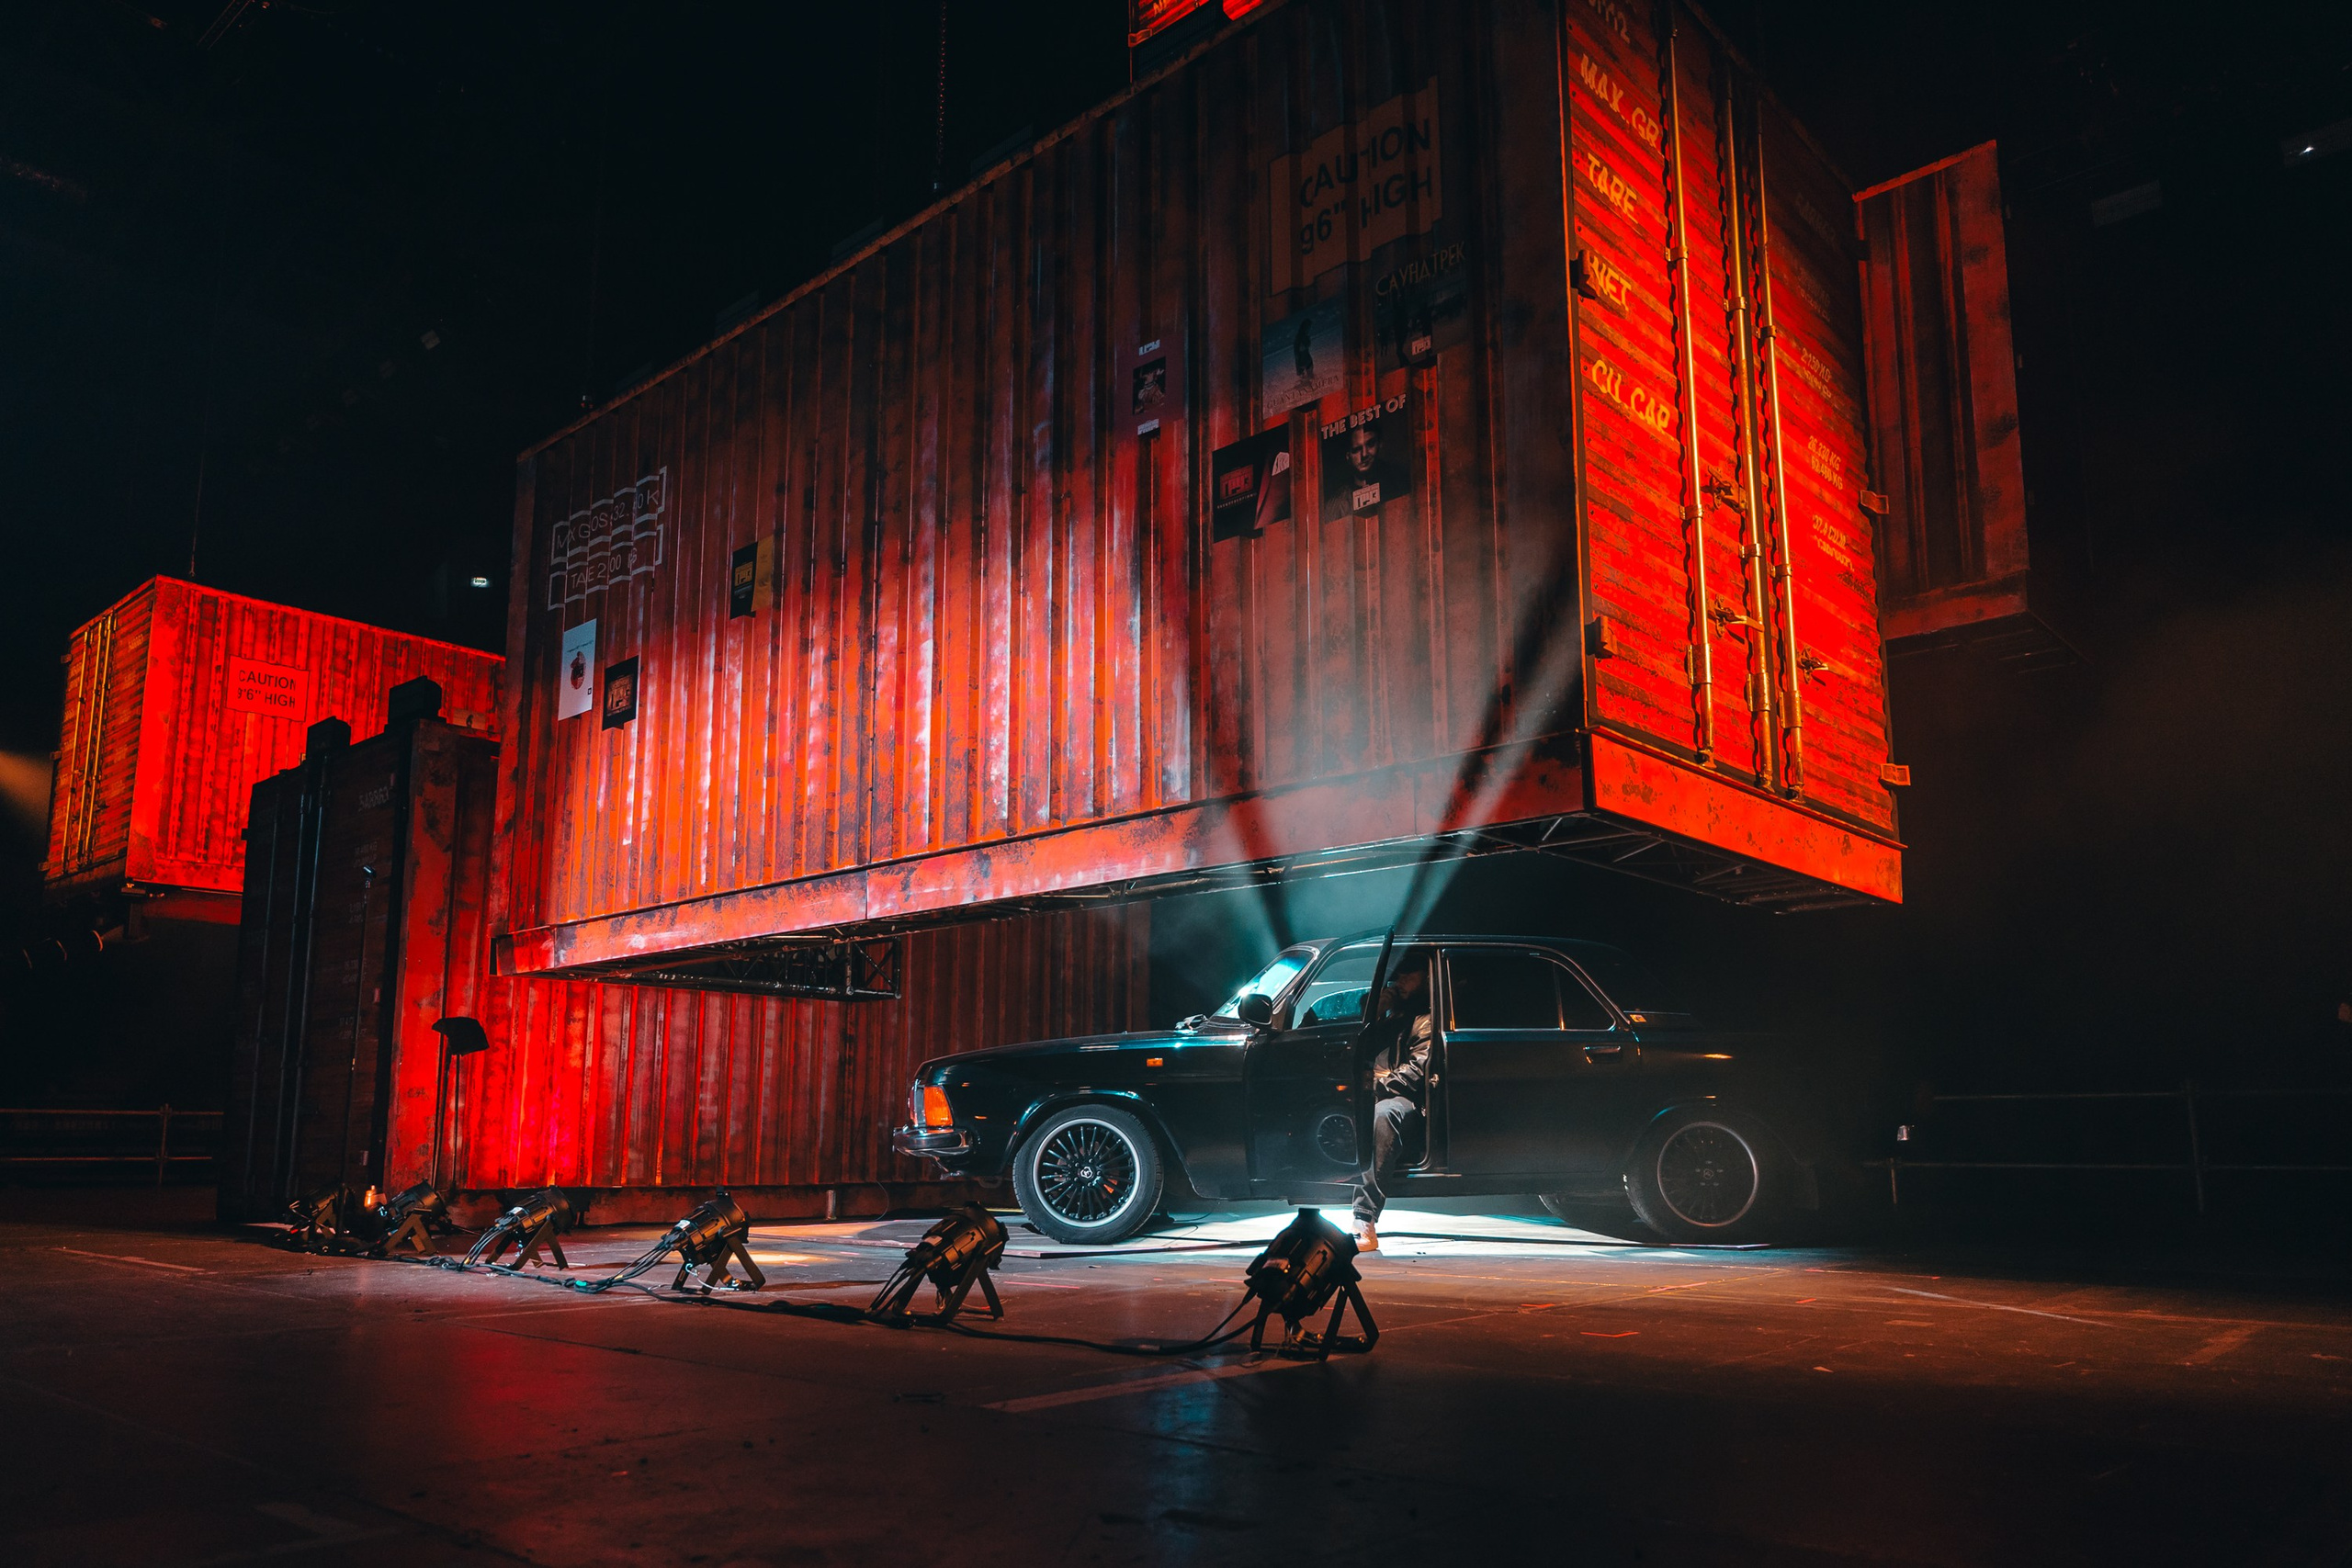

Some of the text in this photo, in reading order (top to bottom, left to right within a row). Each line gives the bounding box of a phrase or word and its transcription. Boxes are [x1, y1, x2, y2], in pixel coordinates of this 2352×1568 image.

[1588, 152, 1638, 224] TARE
[1320, 393, 1407, 440] THE BEST OF
[239, 670, 296, 691] CAUTION
[265, 693, 295, 709] HIGH
